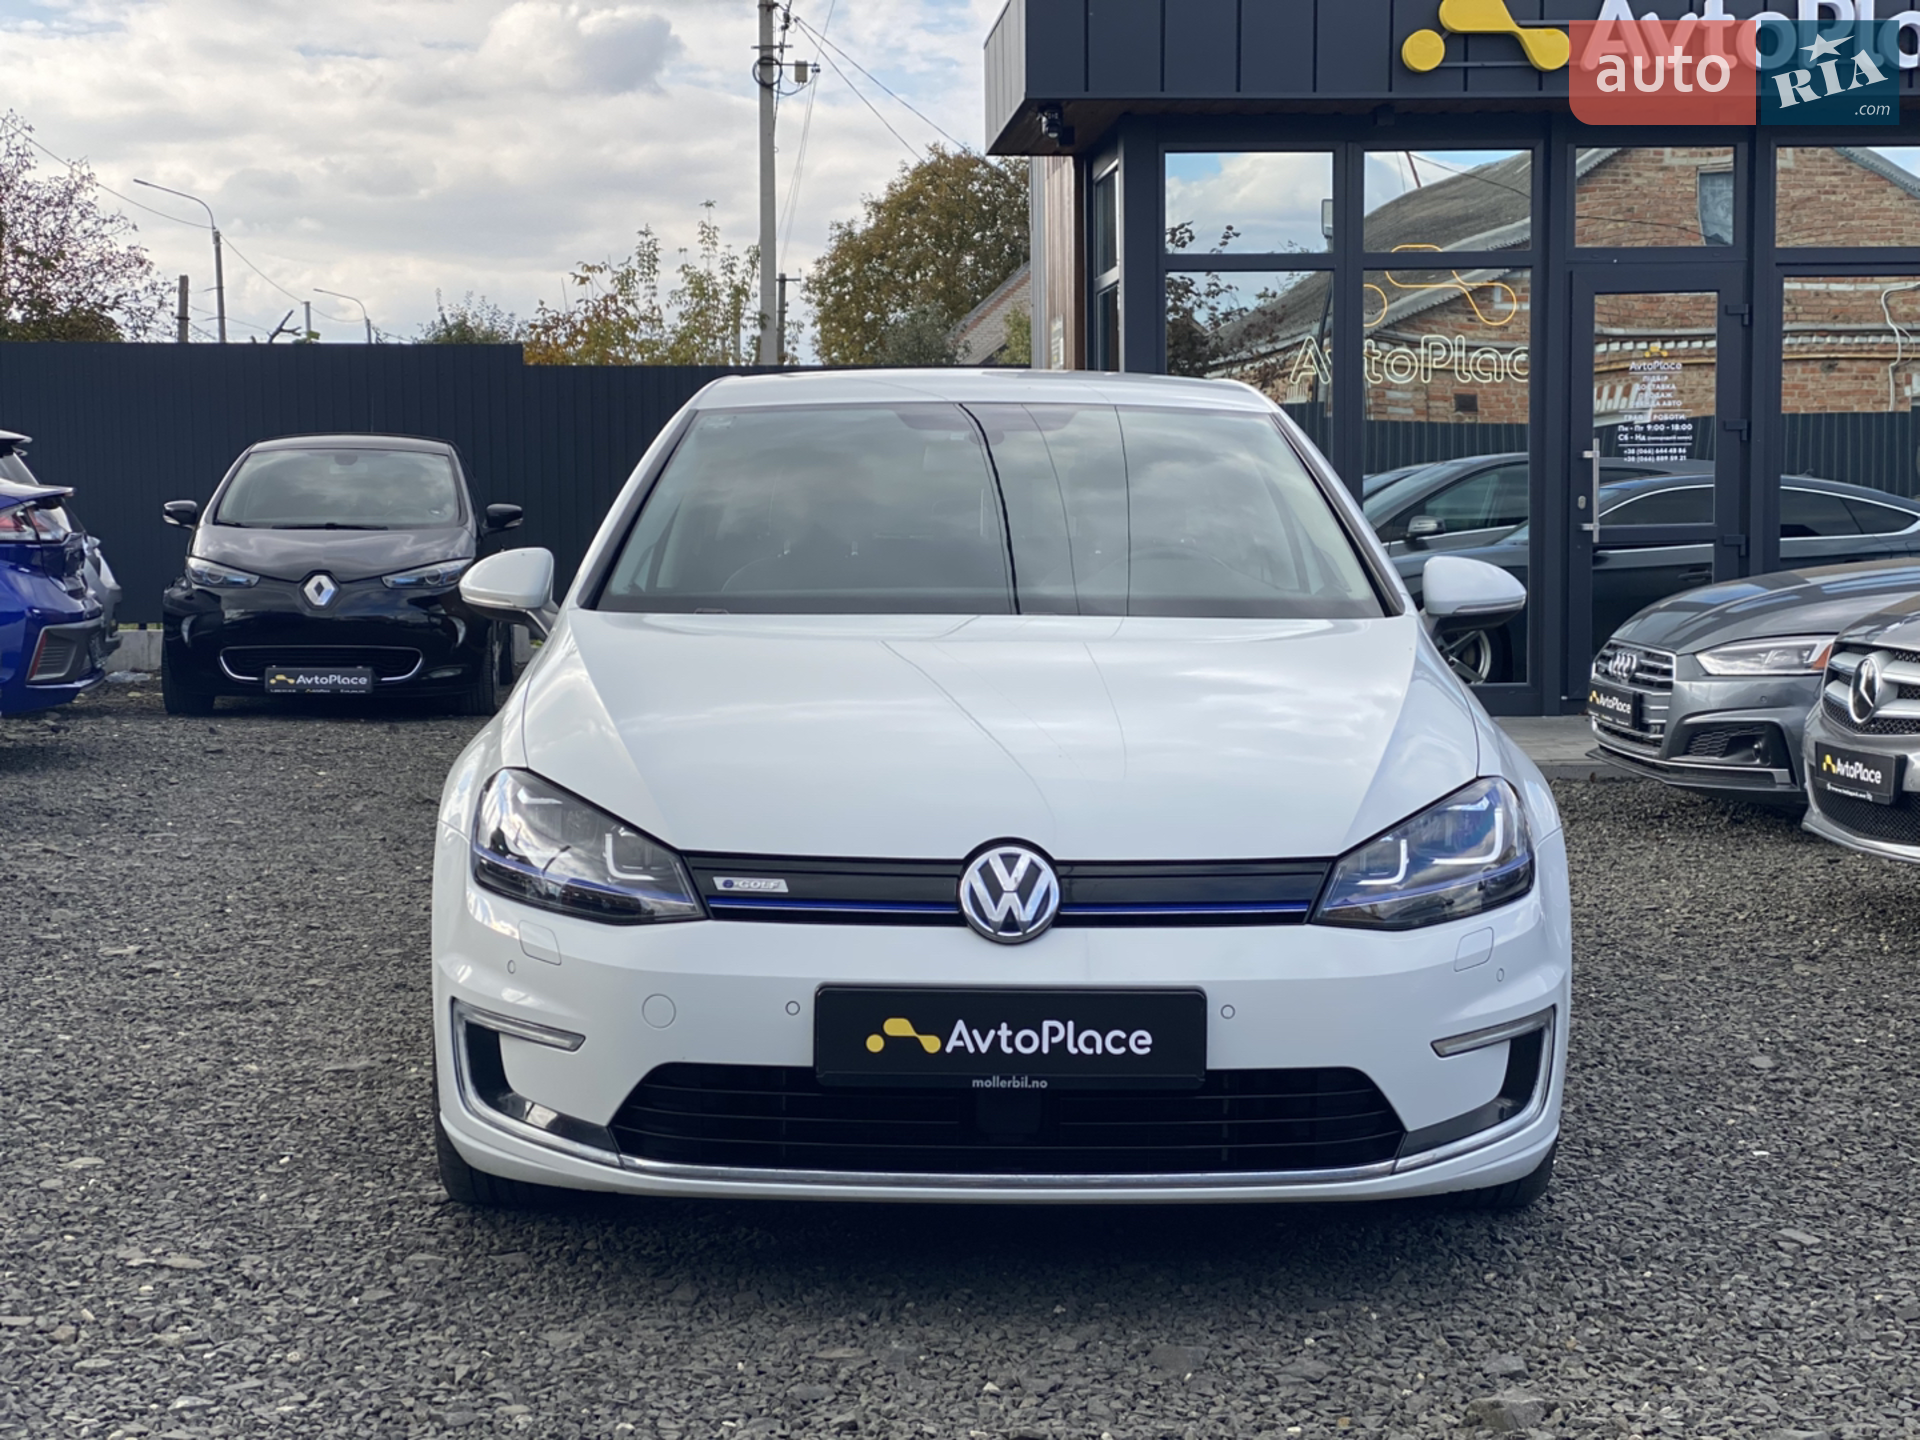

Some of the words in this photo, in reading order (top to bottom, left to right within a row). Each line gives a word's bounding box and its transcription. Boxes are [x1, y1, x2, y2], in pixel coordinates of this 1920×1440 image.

[296, 674, 368, 685] AvtoPlace
[1836, 758, 1882, 784] AvtoPlace
[945, 1019, 1153, 1055] AvtoPlace
[972, 1076, 1048, 1089] mollerbil.no
